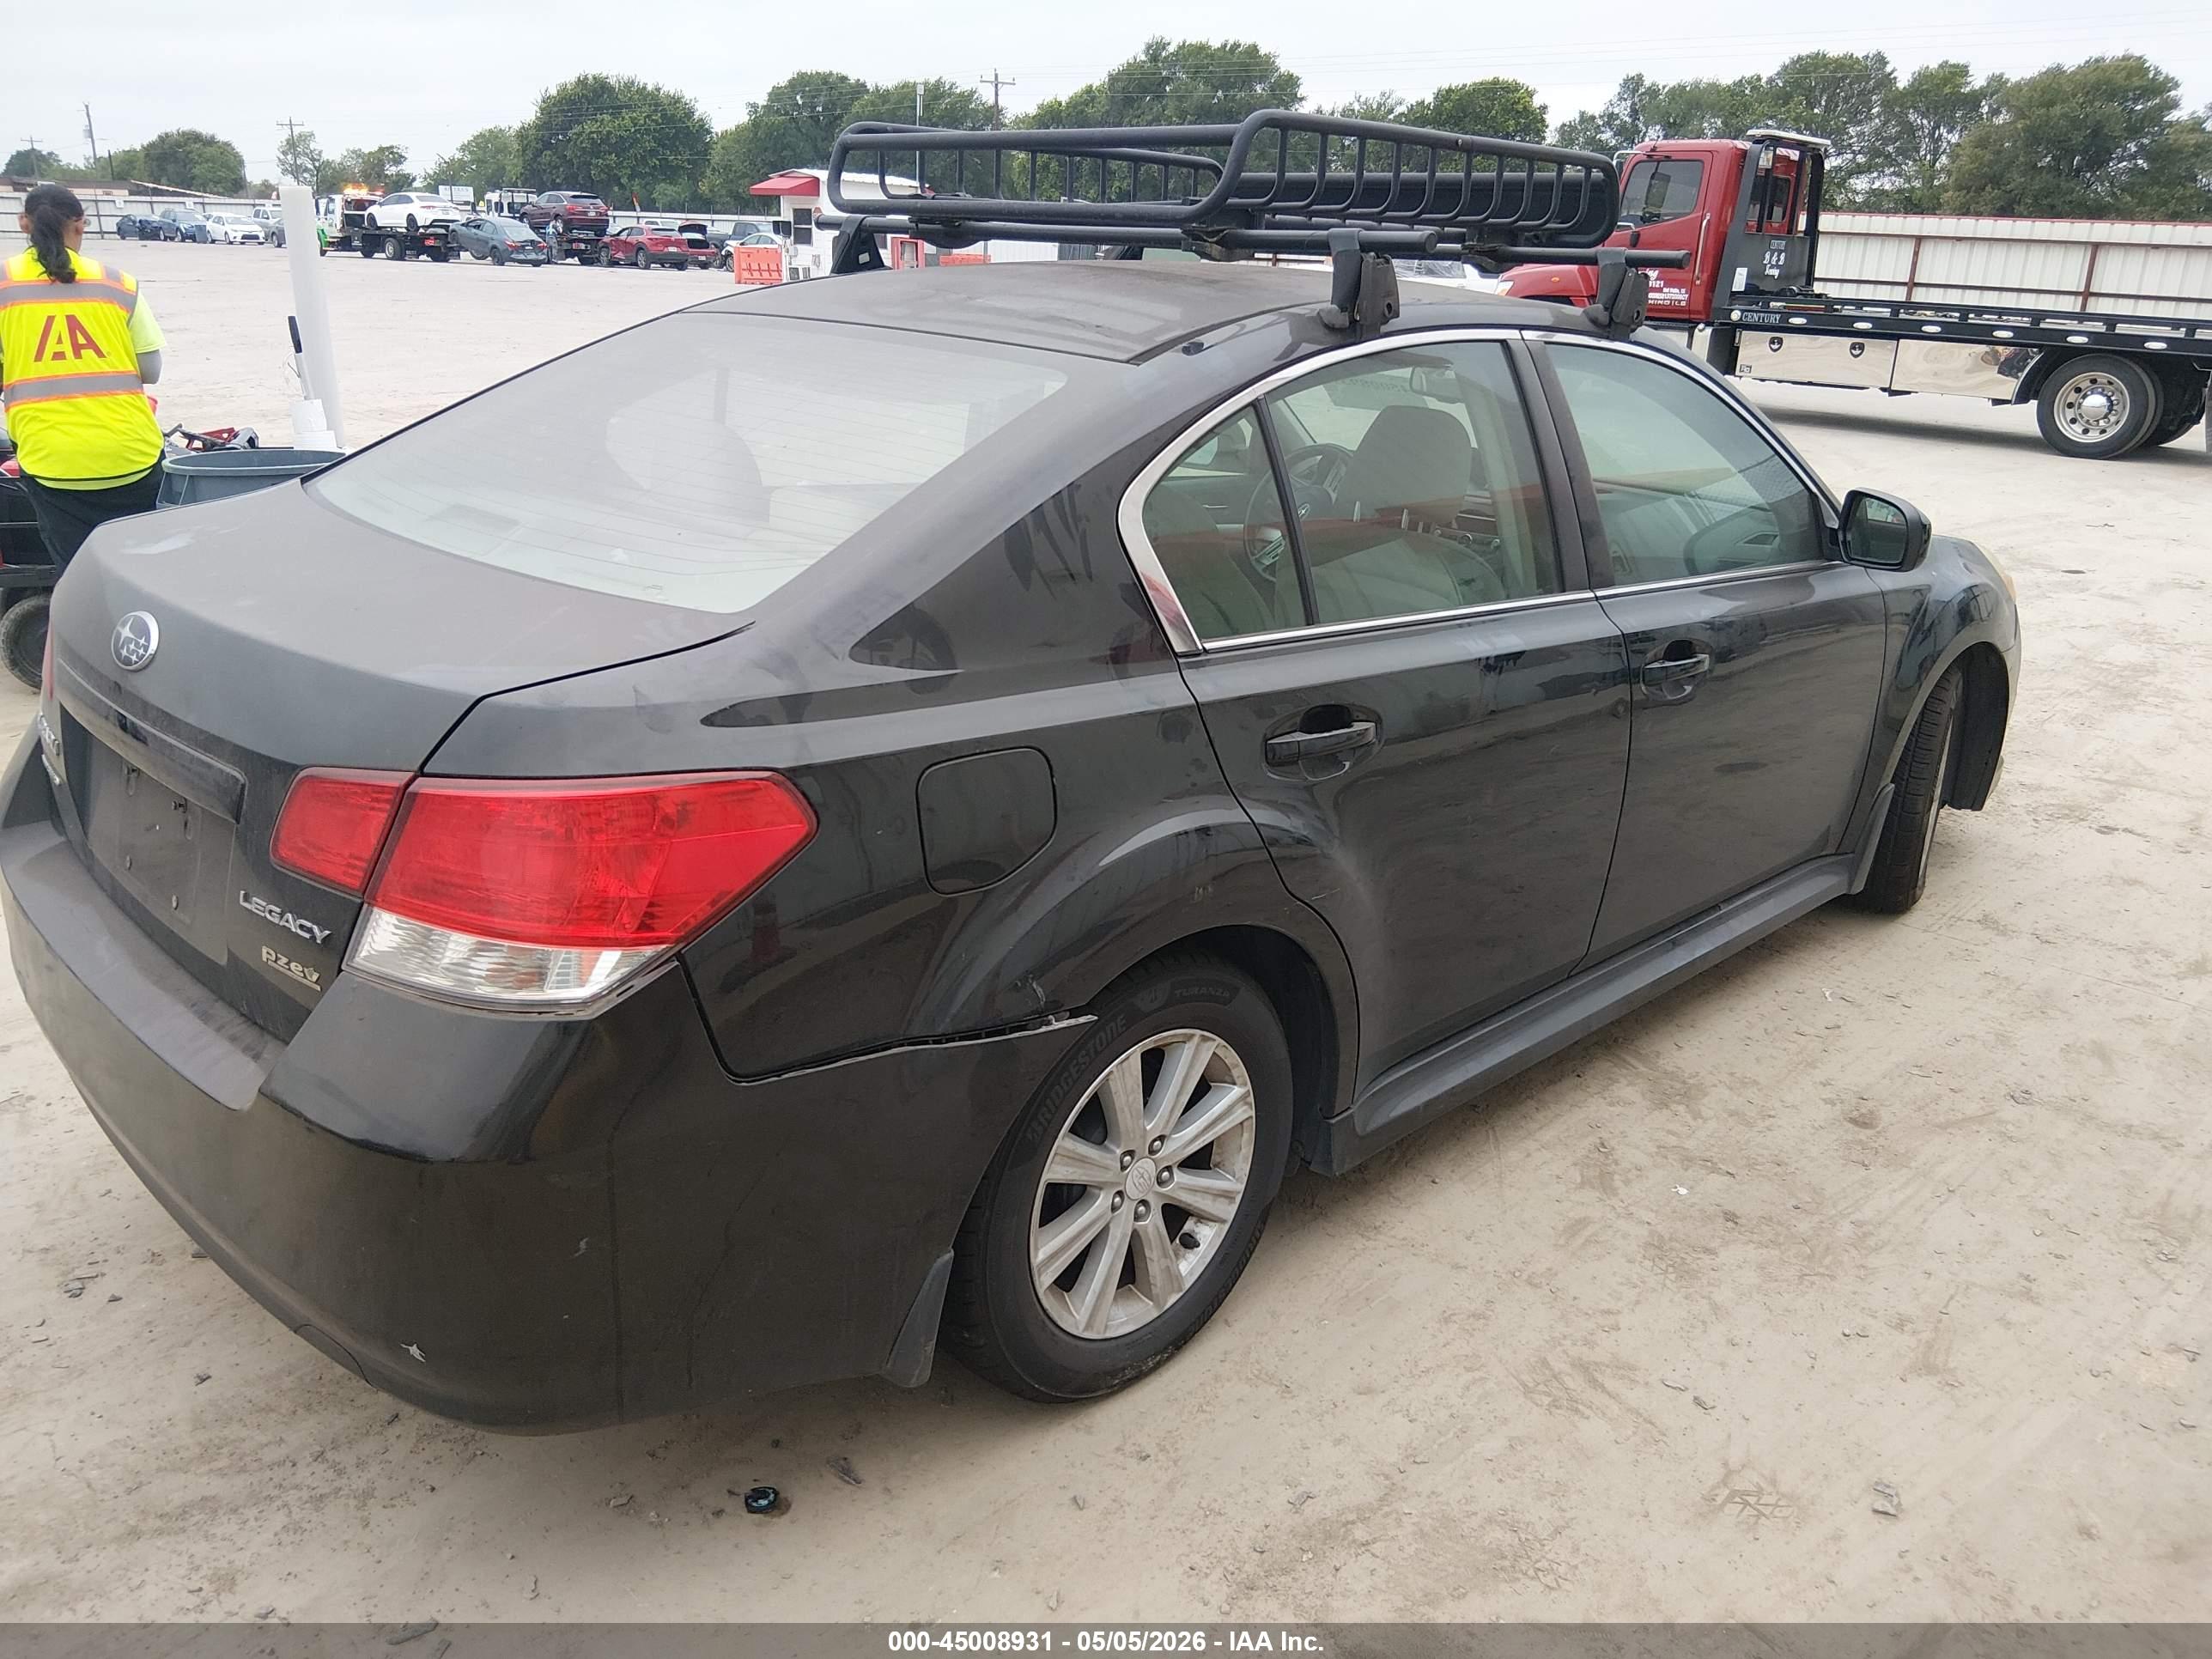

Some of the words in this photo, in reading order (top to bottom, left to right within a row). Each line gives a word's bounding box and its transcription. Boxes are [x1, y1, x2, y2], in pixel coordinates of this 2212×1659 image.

[1741, 312, 1782, 324] CENTURY
[240, 890, 332, 945] LEGACY
[1026, 1013, 1127, 1144] BRIDGESTONE
